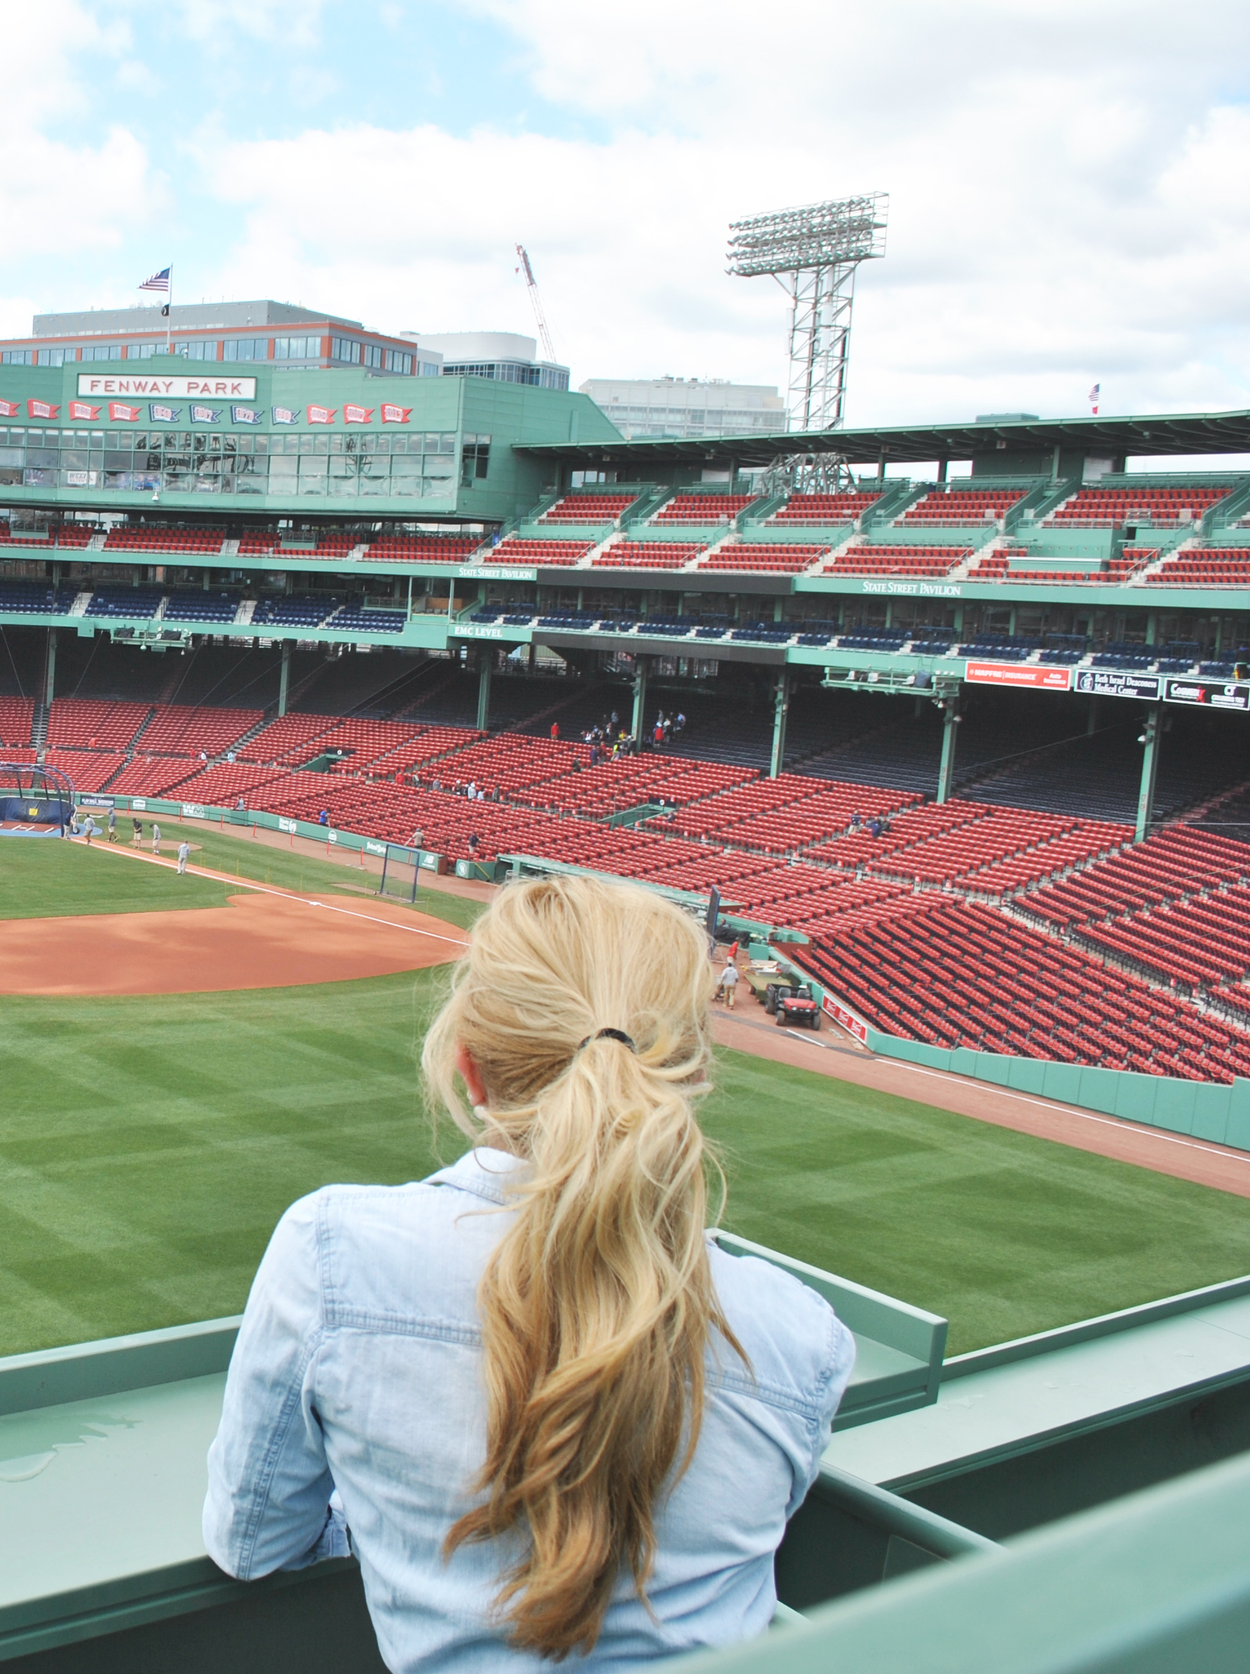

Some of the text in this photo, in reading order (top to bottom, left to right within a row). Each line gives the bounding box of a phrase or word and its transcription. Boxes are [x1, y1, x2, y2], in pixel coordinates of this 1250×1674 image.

[90, 380, 242, 395] FENWAY PARK
[455, 626, 502, 638] EMC LEVEL
